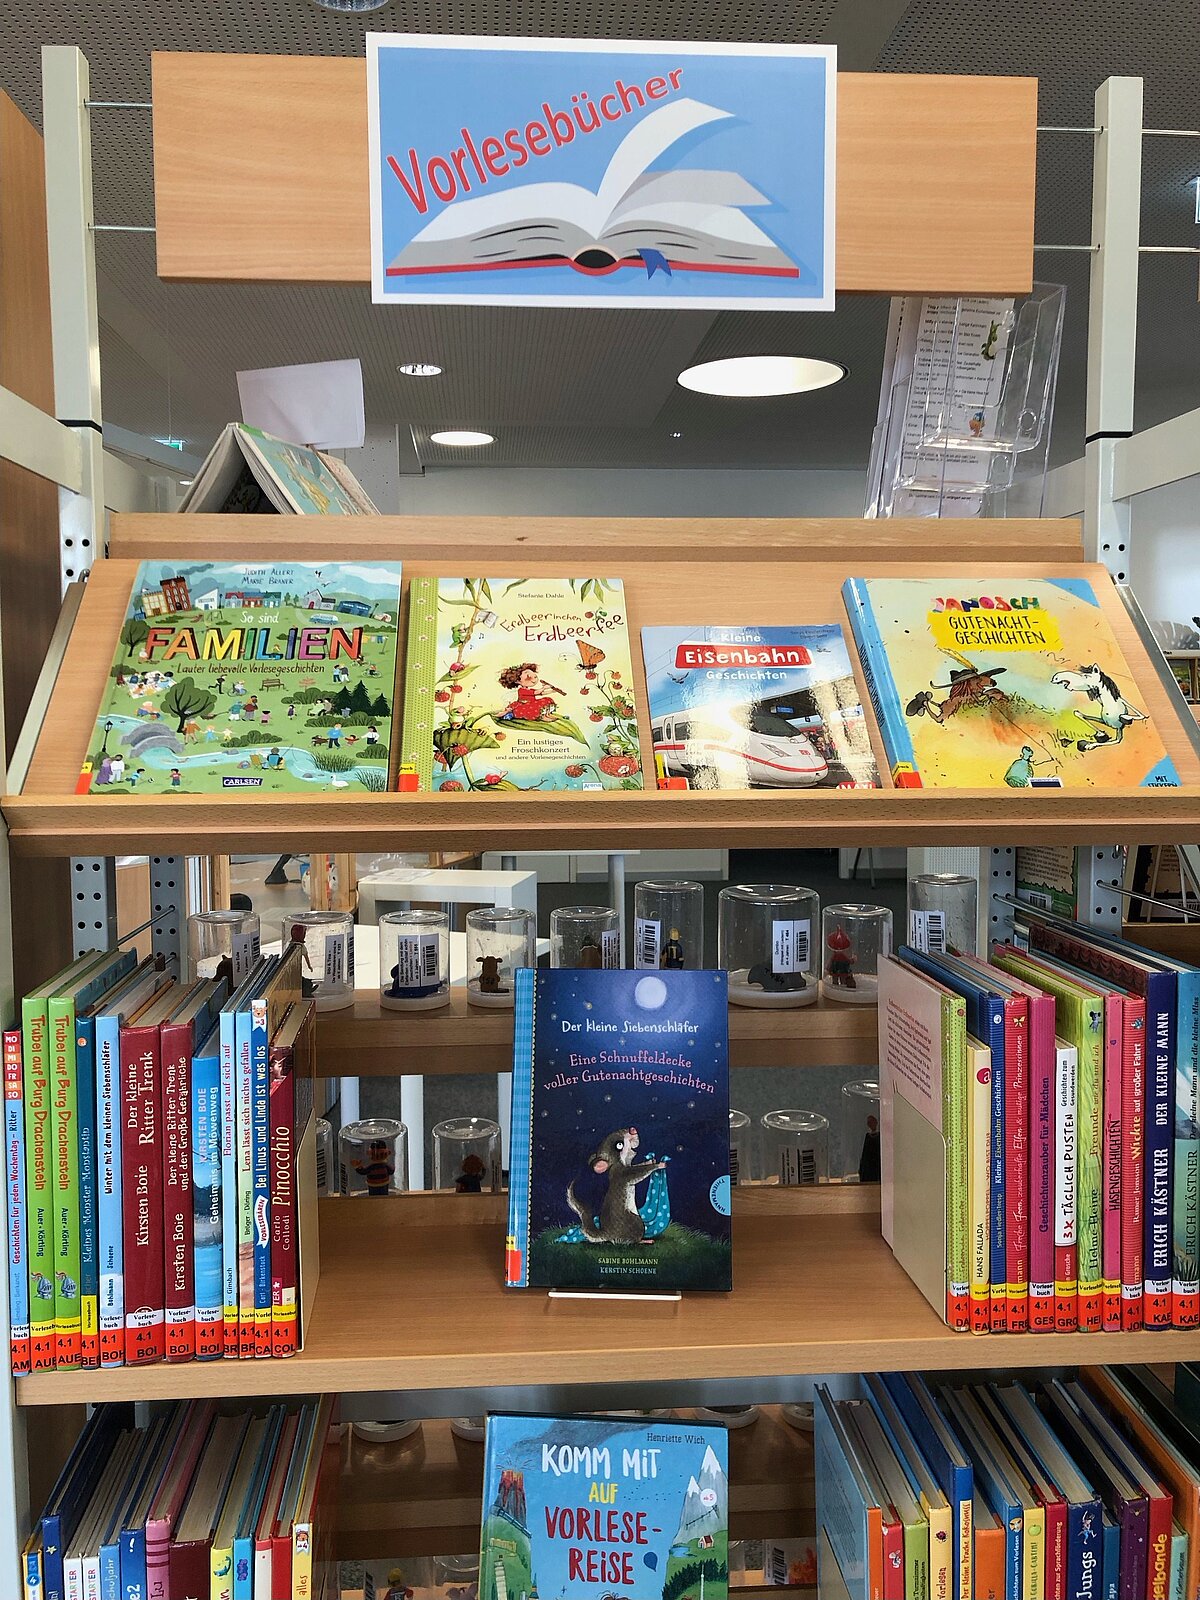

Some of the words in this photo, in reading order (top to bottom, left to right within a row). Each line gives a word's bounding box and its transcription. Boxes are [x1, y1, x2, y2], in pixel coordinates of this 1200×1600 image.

[386, 67, 684, 215] Vorlesebücher
[240, 611, 254, 623] So
[258, 611, 279, 623] sind
[930, 596, 1040, 613] JANOSCH
[500, 612, 582, 633] Erdbeerinchen
[524, 614, 625, 642] Erdbeerfee
[948, 615, 1039, 631] GUTENACHT-
[145, 627, 364, 660] FAMILIEN
[720, 632, 761, 643] Kleine
[955, 630, 1047, 646] GESCHICHTEN
[685, 648, 800, 665] Eisenbahn
[177, 663, 205, 674] Lauter
[208, 663, 247, 674] liebevolle
[249, 663, 325, 676] Vorlesegeschichten
[706, 670, 787, 680] Geschichten
[511, 746, 570, 754] Froschkonzert
[517, 738, 531, 746] Ein
[533, 738, 564, 747] lustiges
[223, 778, 262, 786] CARLSEN
[1155, 775, 1168, 783] MIT
[31, 1014, 46, 1053] Trubel
[55, 1014, 70, 1053] Trubel
[561, 1020, 584, 1034] Der
[586, 1020, 618, 1034] kleine
[621, 1020, 699, 1034] Siebenschläfer
[1156, 1012, 1169, 1049] MANN
[222, 1044, 231, 1061] auf
[242, 1042, 252, 1075] gefallen
[254, 1045, 265, 1060] los
[569, 1053, 597, 1067] Eine
[599, 1051, 692, 1068] Schnuffeldecke
[1013, 1035, 1023, 1090] Prinzessinnen
[1134, 1043, 1142, 1066] Fahrt
[31, 1057, 43, 1076] auf
[55, 1057, 67, 1076] auf
[102, 1040, 111, 1099] Siebenschläfer
[138, 1051, 154, 1096] Trenk
[222, 1063, 231, 1080] sich
[256, 1062, 265, 1081] was
[1156, 1055, 1168, 1096] KLEINE
[126, 1063, 138, 1102] kleine
[166, 1064, 176, 1095] Trenk
[177, 1057, 187, 1115] Gefährliche
[223, 1082, 231, 1099] auf
[242, 1078, 250, 1106] nichts
[254, 1083, 265, 1098] ist
[543, 1073, 579, 1090] voller
[581, 1068, 715, 1093] Gutenachtgeschichten
[1093, 1077, 1099, 1090] du
[30, 1079, 46, 1108] Burg
[55, 1079, 71, 1108] Burg
[1040, 1077, 1049, 1122] Mädchen
[9, 1110, 18, 1132] Ritter
[103, 1102, 112, 1129] kleinen
[127, 1105, 138, 1129] Der
[138, 1100, 154, 1145] Ritter
[167, 1097, 177, 1130] Ritter
[208, 1087, 219, 1147] Möwenweg
[223, 1101, 233, 1123] passt
[242, 1109, 250, 1126] sich
[255, 1100, 265, 1122] Linda
[1156, 1102, 1167, 1125] DER
[104, 1131, 112, 1148] dem
[178, 1117, 188, 1150] Große
[223, 1126, 232, 1156] Florian
[242, 1128, 250, 1148] lässt
[255, 1126, 265, 1143] und
[1013, 1128, 1026, 1150] Elfen
[1039, 1125, 1049, 1140] für
[1063, 1113, 1074, 1161] PUSTEN
[1090, 1108, 1099, 1155] Freunde
[1130, 1116, 1141, 1160] Wickie
[33, 1111, 48, 1191] Drachenstein
[58, 1111, 72, 1191] Drachenstein
[104, 1150, 112, 1164] mit
[168, 1133, 177, 1163] kleine
[209, 1152, 218, 1166] im
[255, 1145, 266, 1171] Linus
[10, 1140, 20, 1182] Wochentag
[179, 1152, 188, 1171] der
[242, 1151, 251, 1171] Lena
[271, 1126, 291, 1206] Pinocchio
[1109, 1119, 1121, 1211] HASENGESCHICHTEN
[105, 1167, 113, 1194] Winter
[134, 1165, 149, 1195] Boie
[168, 1166, 178, 1185] Der
[180, 1173, 189, 1191] und
[256, 1173, 266, 1188] Bei
[1014, 1153, 1026, 1197] zauberhafte
[1039, 1142, 1049, 1232] Geschichtenzauber
[1151, 1149, 1168, 1216] KÄSTNER
[1184, 1150, 1198, 1212] KÄSTNER
[11, 1183, 22, 1204] jeden
[209, 1169, 219, 1225] Geheimnis
[710, 1177, 726, 1213] THIENEMANN
[1062, 1165, 1074, 1216] TÄGLICH
[136, 1198, 149, 1247] Kirsten
[173, 1213, 184, 1241] Boie
[282, 1215, 290, 1250] Collodi
[12, 1218, 21, 1264] Geschichten
[1154, 1224, 1168, 1267] ERICH
[1185, 1215, 1196, 1256] ERICH
[173, 1244, 186, 1291] Kirsten
[598, 1257, 620, 1265] SABINE
[621, 1257, 659, 1265] BOHLMANN
[600, 1266, 628, 1274] KERSTIN
[628, 1267, 657, 1275] SCHOENE
[1034, 1316, 1054, 1325] GES
[137, 1346, 157, 1358] BOI
[169, 1344, 190, 1354] BOI
[201, 1344, 220, 1353] BOI
[646, 1432, 682, 1444] Henriette
[684, 1434, 706, 1445] Wich
[541, 1443, 611, 1479] KOMM
[588, 1482, 619, 1504] AUF
[544, 1506, 662, 1545] VORLESE-
[963, 1503, 971, 1538] Kokosnuss
[962, 1540, 970, 1563] Drache
[1055, 1521, 1063, 1572] Sprachförderung
[296, 1575, 308, 1596] alles
[936, 1567, 947, 1600] Vorlesen
[962, 1566, 970, 1586] kleine
[1076, 1551, 1097, 1599] Jungs
[961, 1588, 969, 1599] Der
